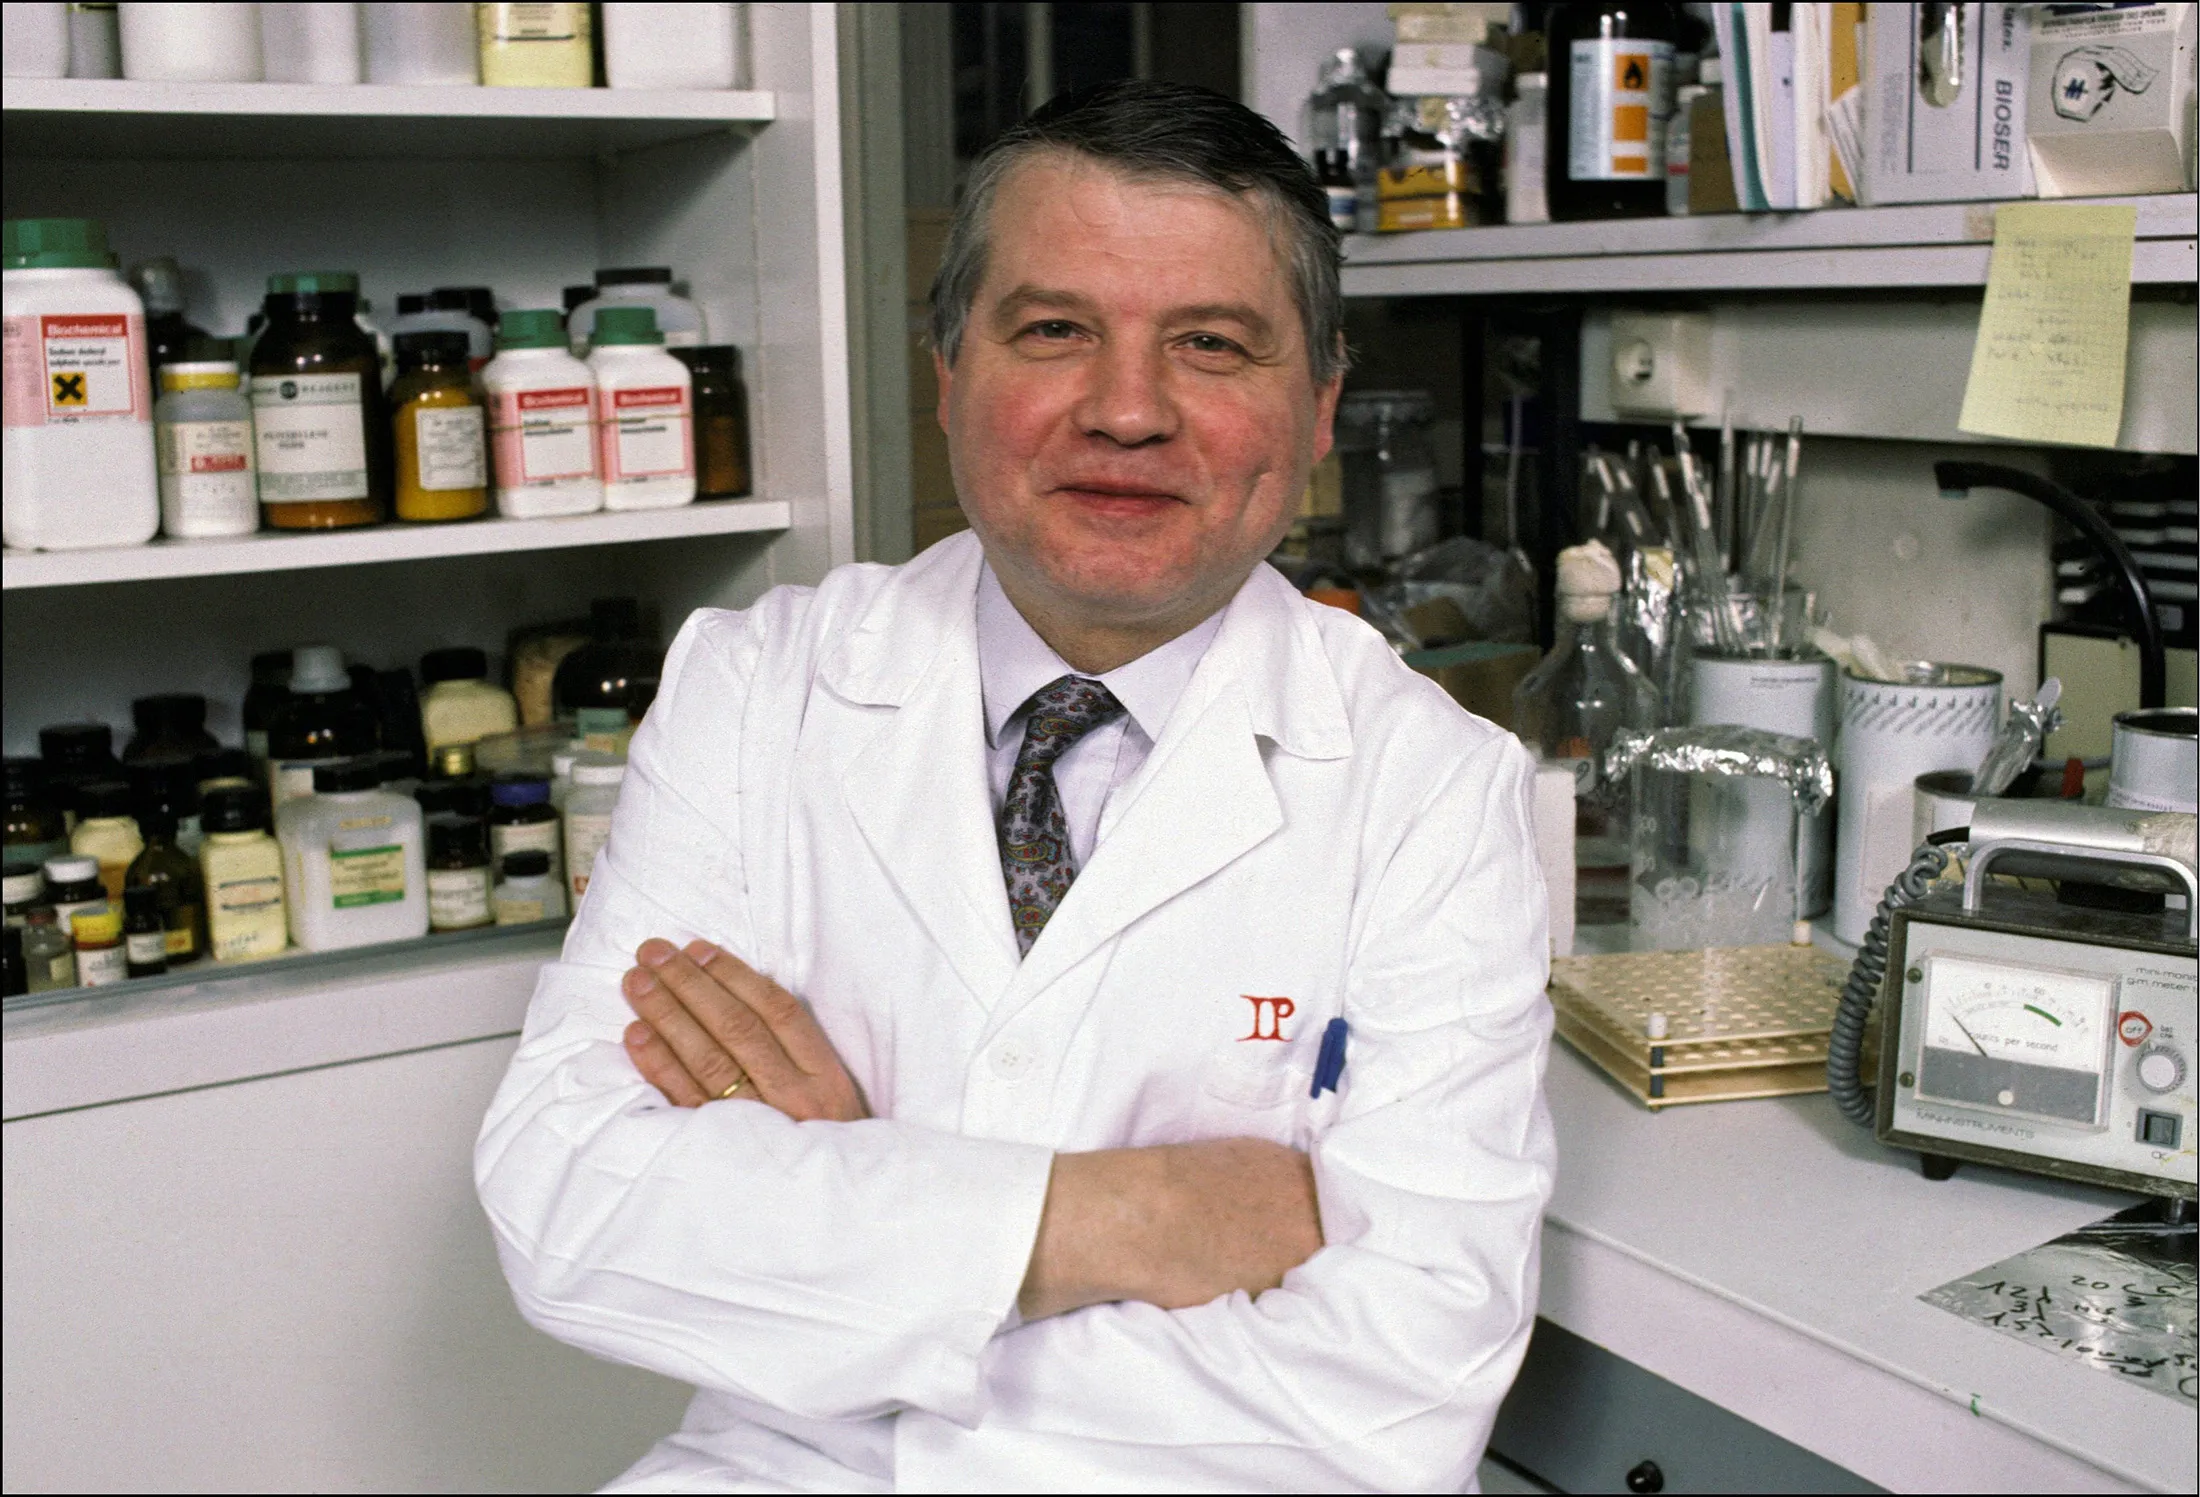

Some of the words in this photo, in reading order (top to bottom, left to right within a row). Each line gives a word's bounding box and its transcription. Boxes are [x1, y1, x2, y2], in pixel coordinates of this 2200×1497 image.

[1993, 79, 2013, 171] BIOSER
[47, 323, 122, 337] Biochemical
[523, 393, 584, 406] Biochemical
[619, 392, 678, 404] Biochemical
[2152, 980, 2189, 992] meter
[1236, 995, 1295, 1042] IP
[2005, 1037, 2021, 1047] per
[2026, 1040, 2058, 1051] second
